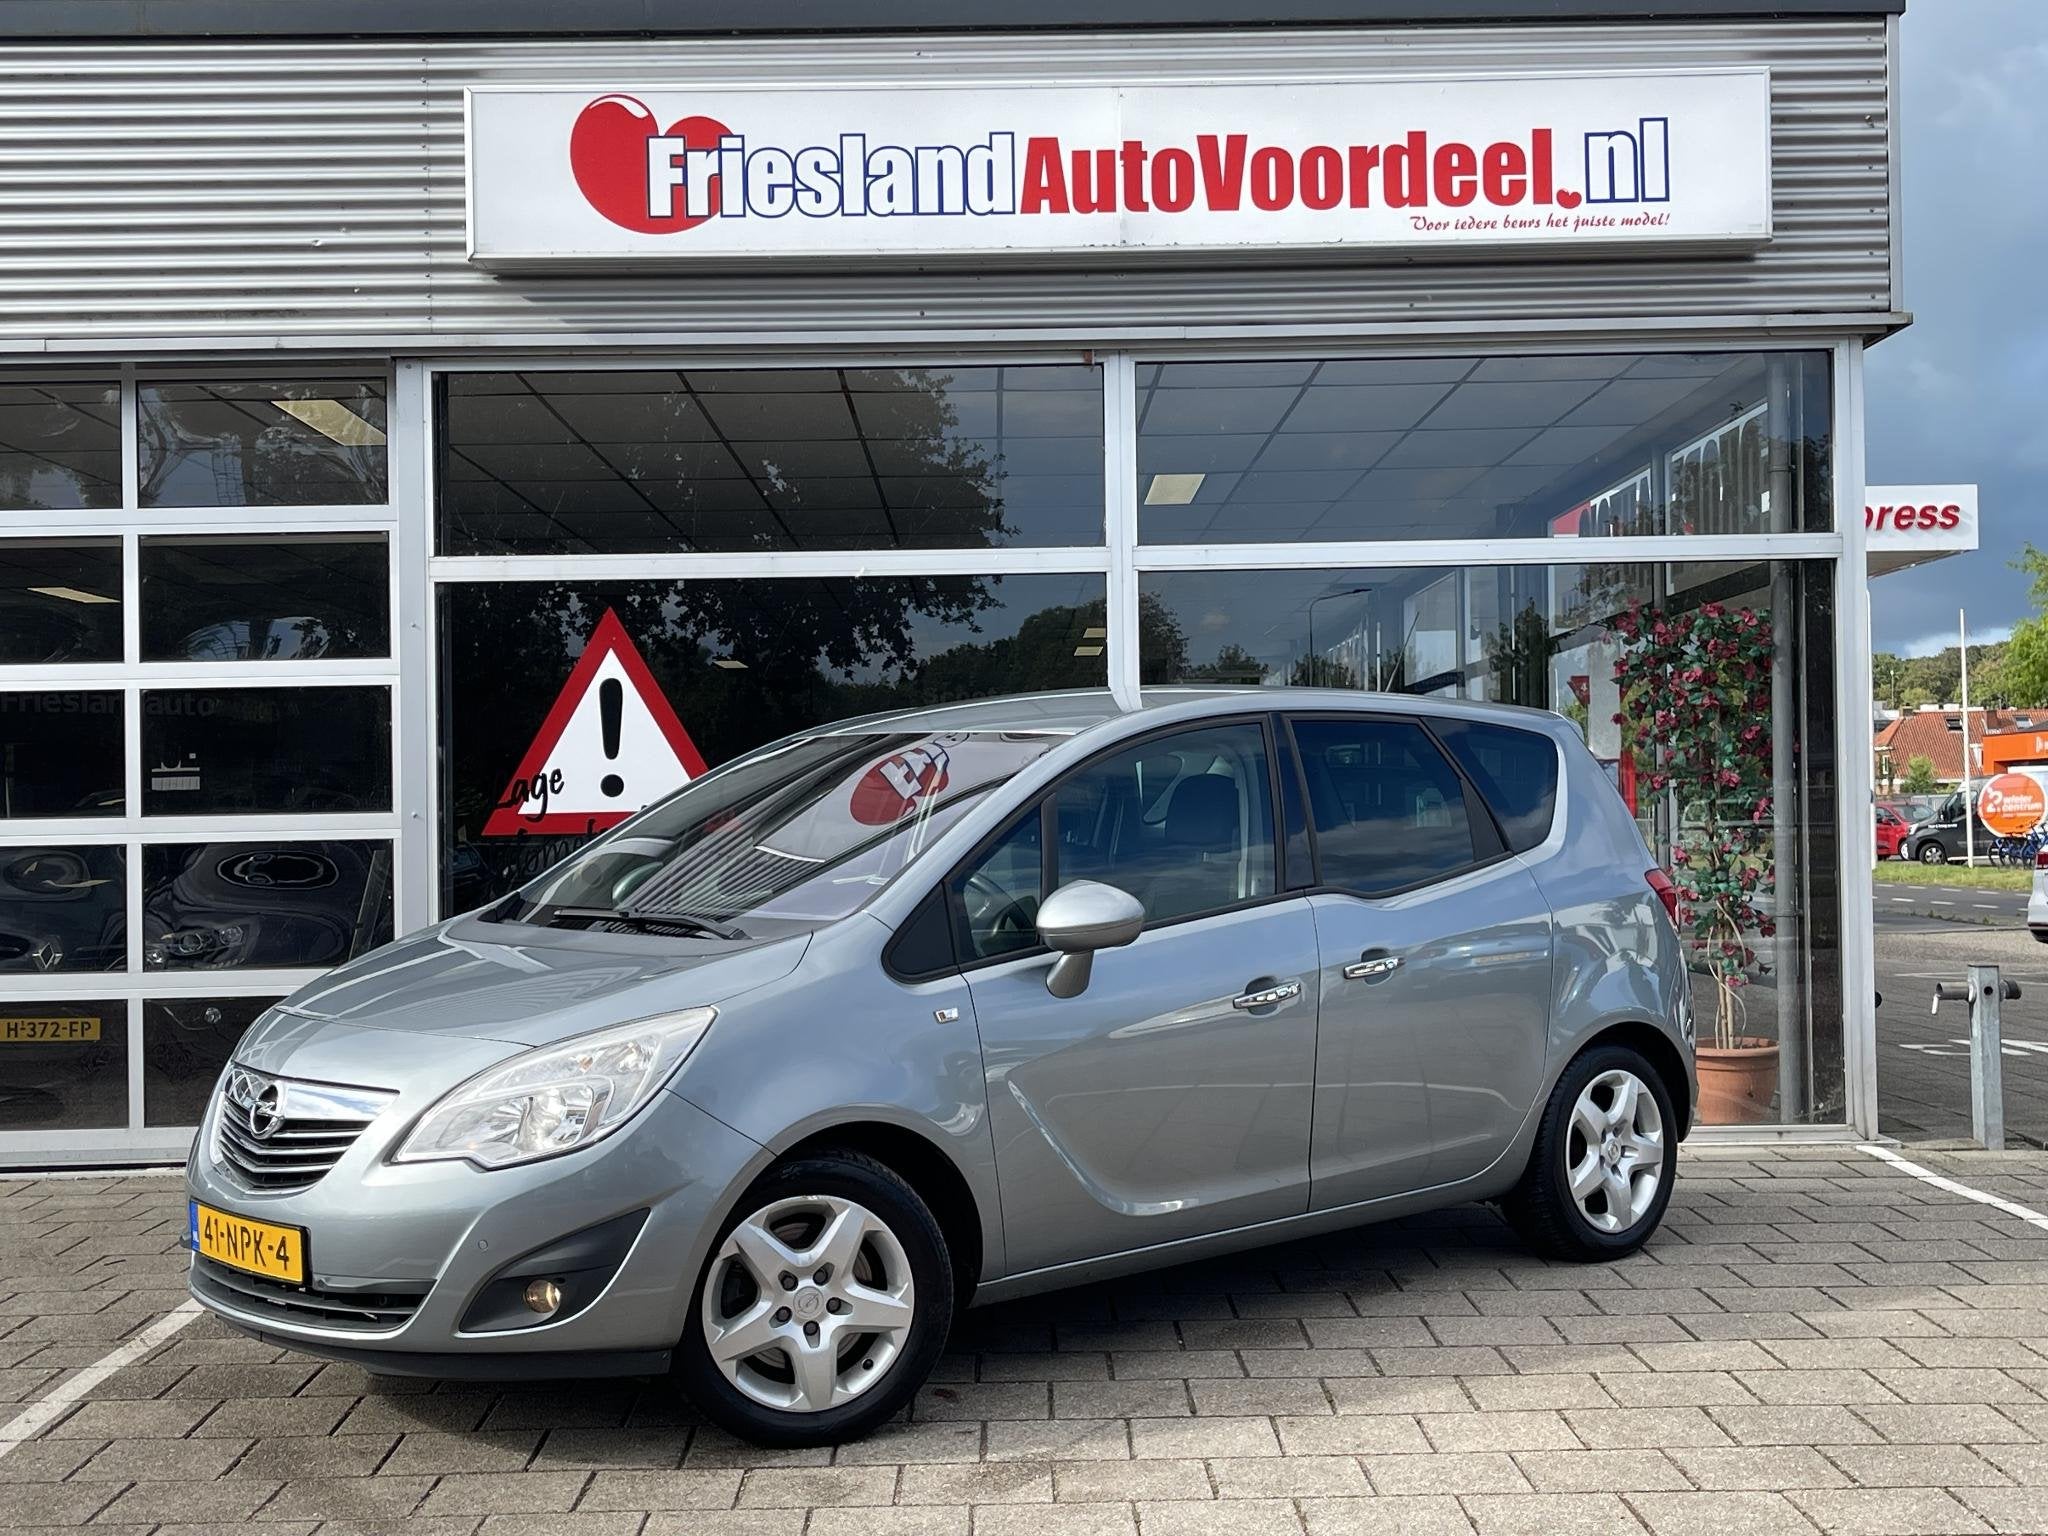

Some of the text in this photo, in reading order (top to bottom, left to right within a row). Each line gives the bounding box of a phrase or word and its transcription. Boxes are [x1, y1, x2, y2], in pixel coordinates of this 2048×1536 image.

[1410, 212, 1671, 232] Voor iedere beurs het juiste model!
[497, 768, 565, 822] age
[204, 1215, 289, 1271] 41-NPK-4
